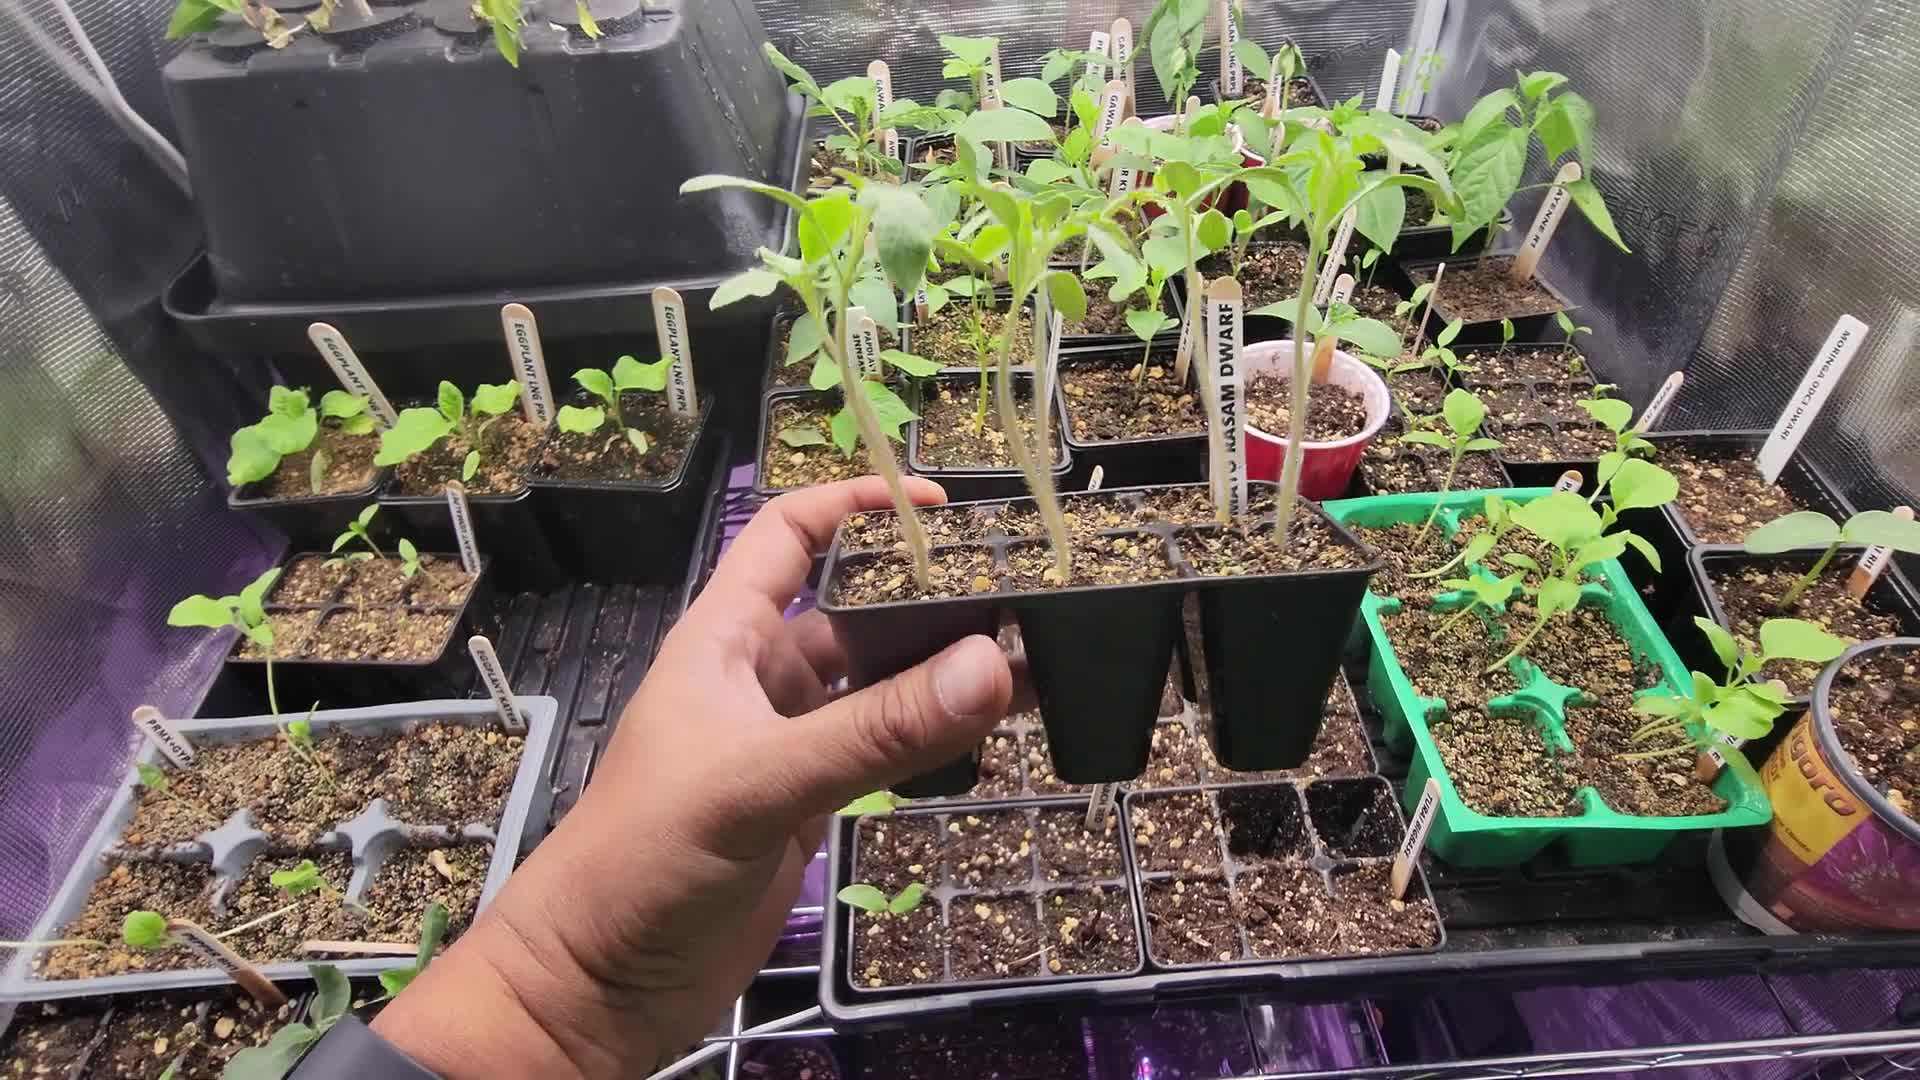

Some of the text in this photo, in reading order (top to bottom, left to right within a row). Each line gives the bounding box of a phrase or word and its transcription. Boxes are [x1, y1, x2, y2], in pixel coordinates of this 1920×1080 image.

[514, 322, 535, 382] EGGPLANT
[527, 382, 539, 401] LNG
[665, 306, 682, 365] EGGPLANT
[1217, 303, 1234, 378] DWARF
[1818, 330, 1851, 380] MORINGA
[323, 337, 366, 393] EGGPLANT
[673, 364, 682, 387] LNG
[1420, 793, 1433, 824] TURAI
